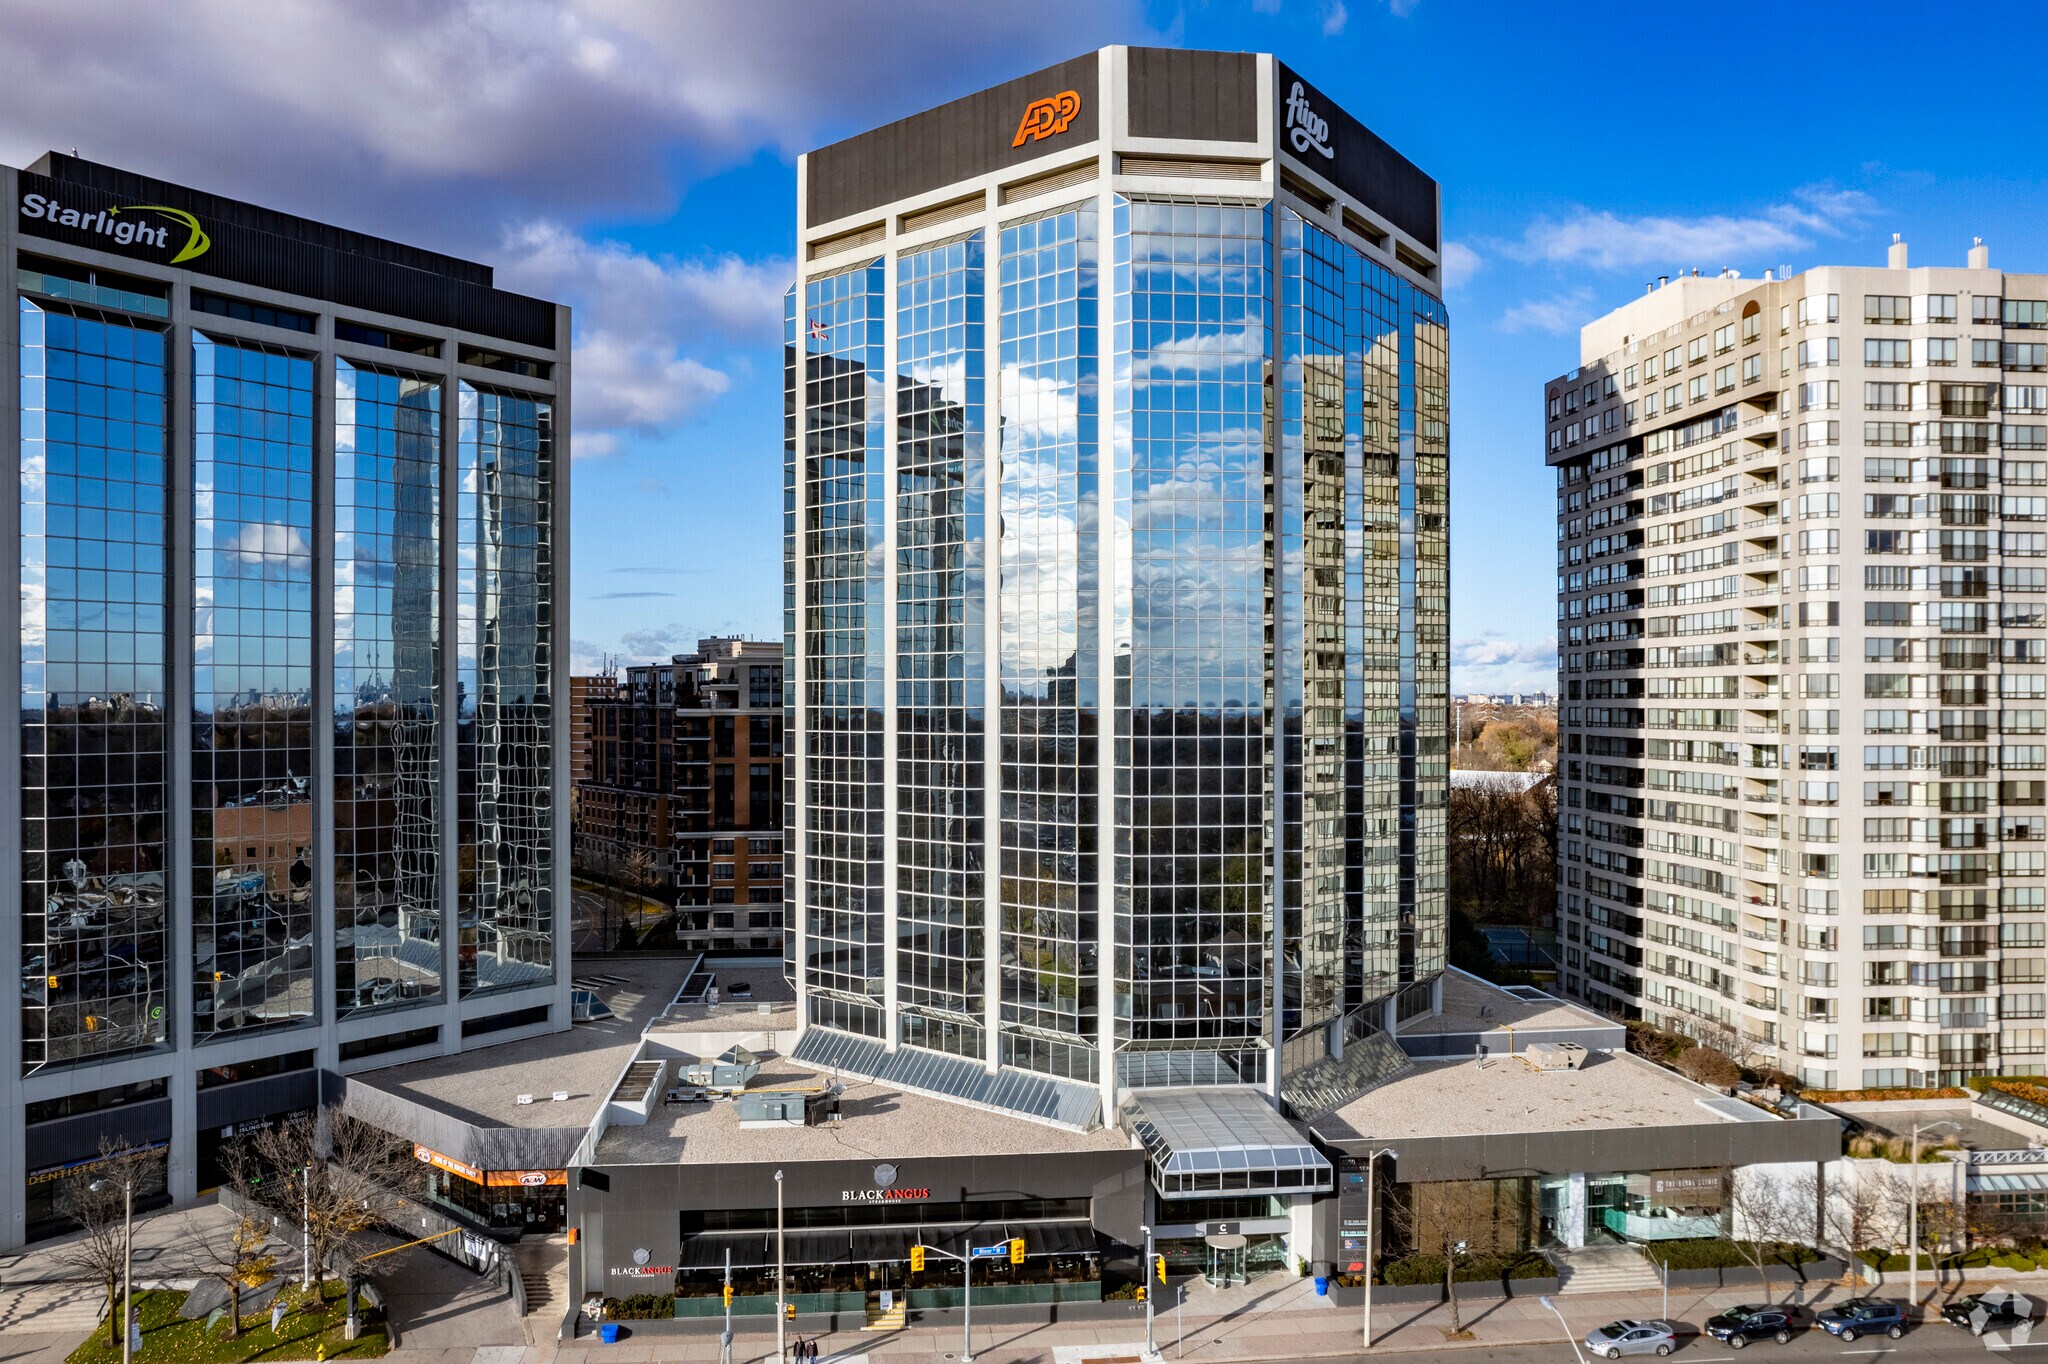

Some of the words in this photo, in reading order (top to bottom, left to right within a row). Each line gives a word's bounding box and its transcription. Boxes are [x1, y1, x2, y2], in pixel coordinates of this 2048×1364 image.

[1011, 89, 1081, 149] ADP
[1285, 81, 1334, 159] flipp
[20, 193, 169, 249] Starlight
[239, 1120, 274, 1133] ISLINGTON
[28, 1161, 106, 1185] DENTISTRY
[842, 1190, 884, 1201] BLACK
[885, 1188, 929, 1200] ANGUS
[1219, 1223, 1227, 1232] C
[611, 1267, 641, 1276] BLACK
[641, 1266, 673, 1275] ANGUS
